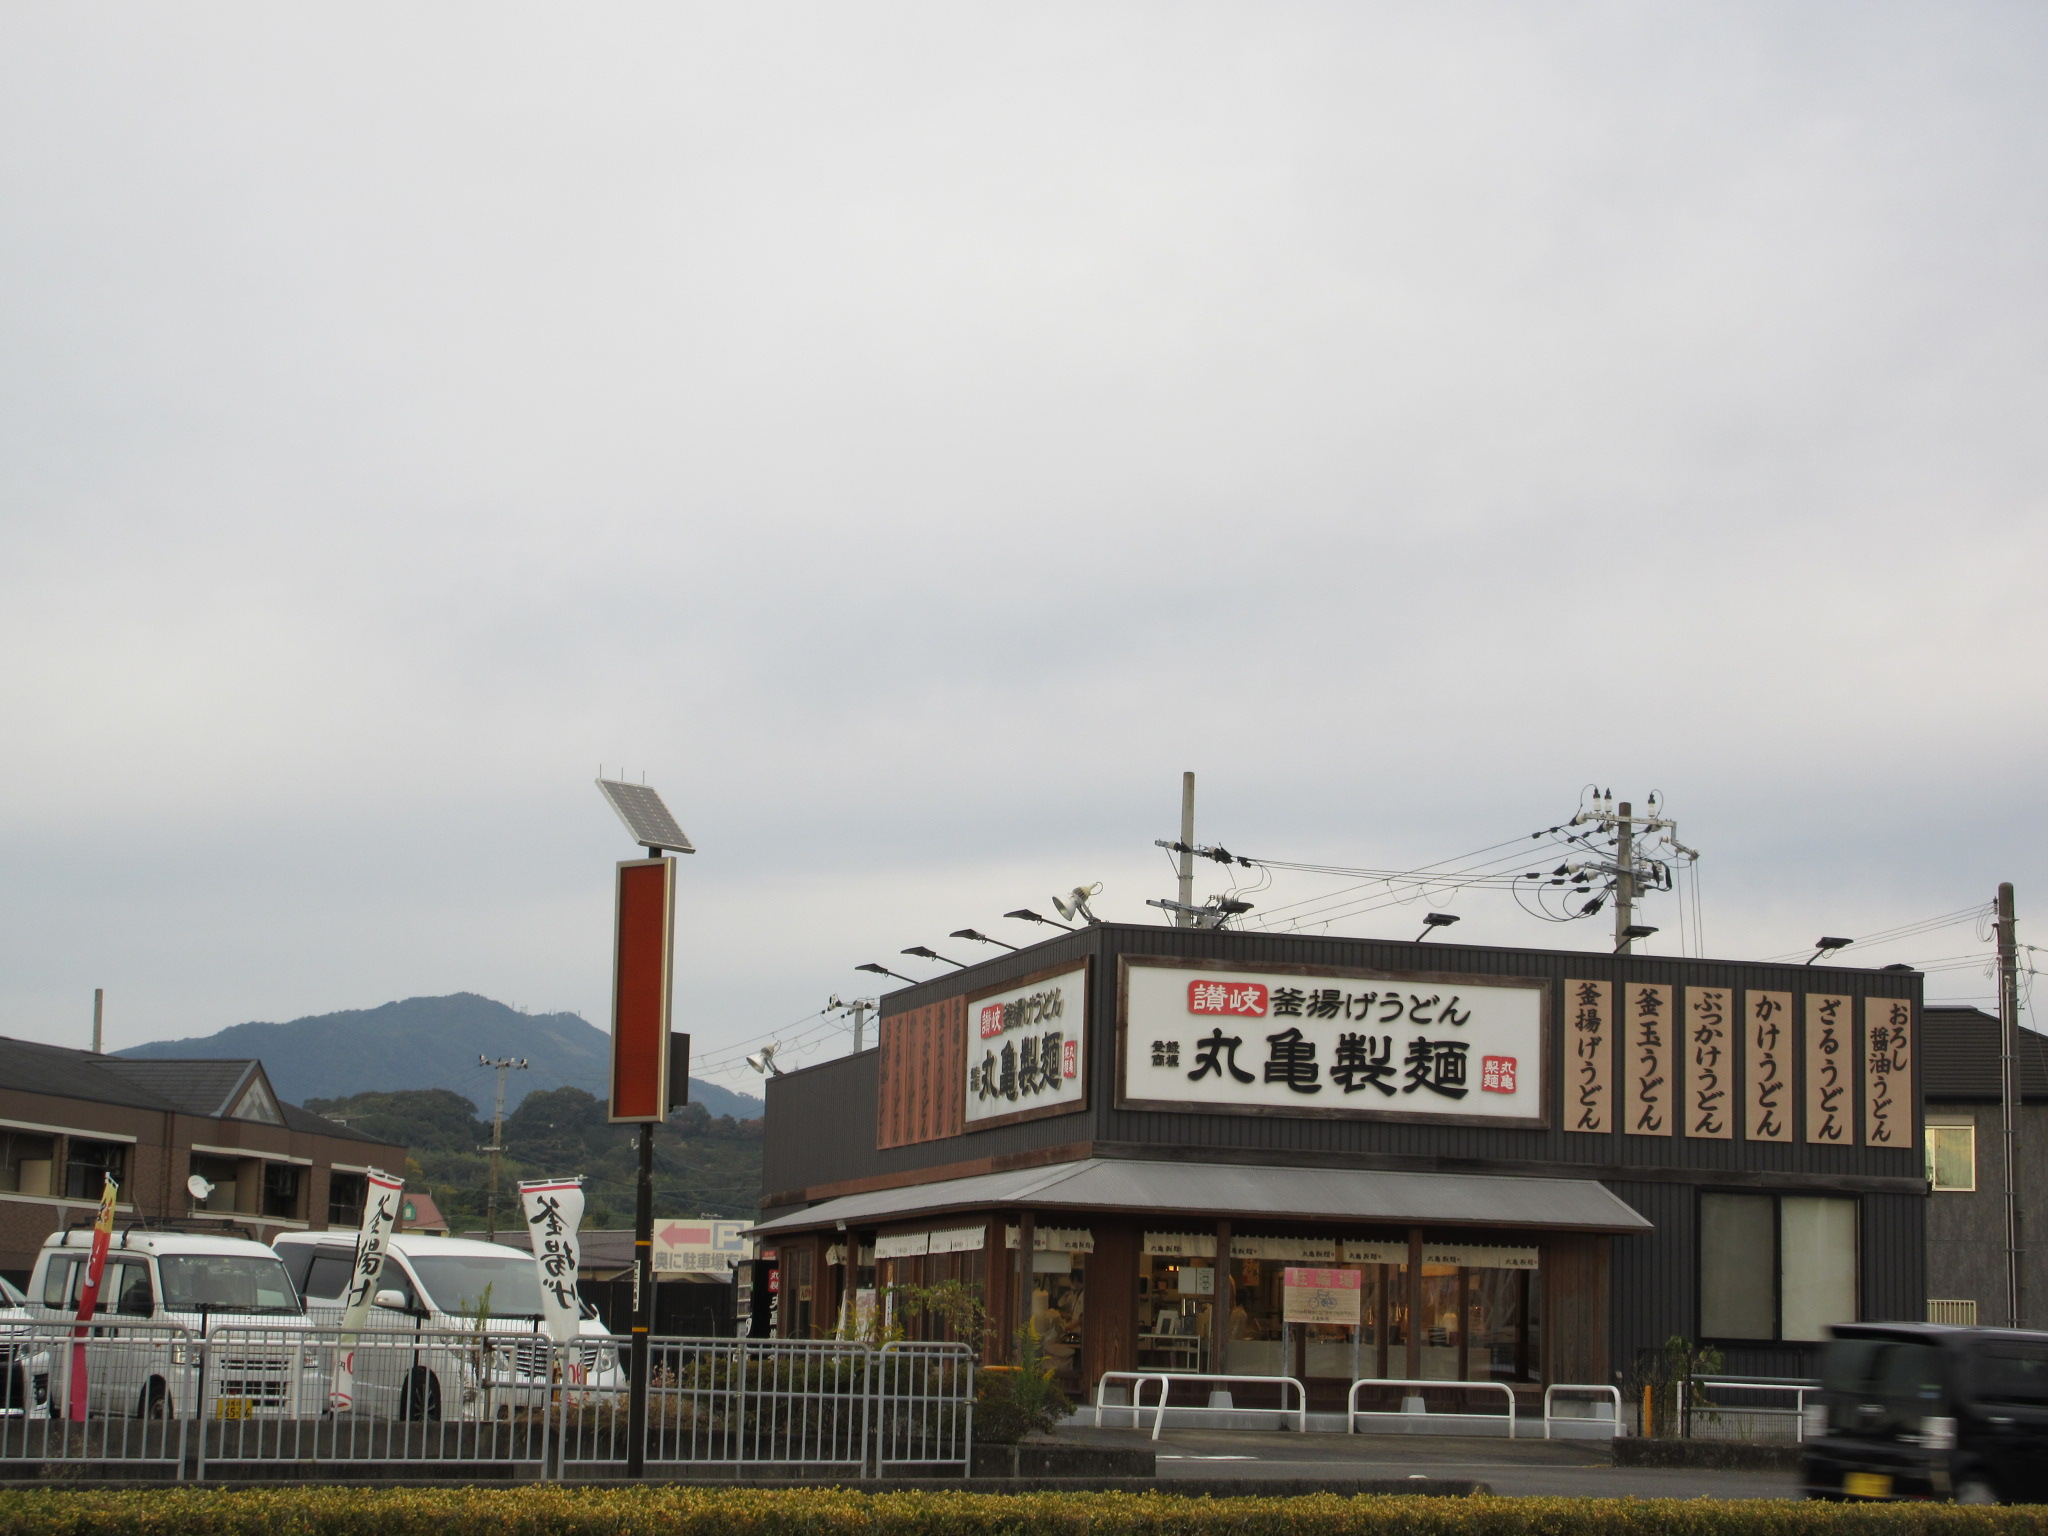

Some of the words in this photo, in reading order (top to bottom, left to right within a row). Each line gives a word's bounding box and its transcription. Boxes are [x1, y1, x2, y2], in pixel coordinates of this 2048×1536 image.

[979, 1031, 1064, 1101] 丸亀製麺
[1187, 1027, 1471, 1100] 丸亀製麺
[1193, 984, 1264, 1014] 讃岐
[1270, 987, 1471, 1026] 釜揚げうどん
[1575, 981, 1603, 1130] 釜揚げうどん
[1635, 988, 1664, 1131] 釜玉うどん
[1693, 991, 1723, 1134] ぶっかけうどん
[1755, 994, 1782, 1137] かけうどん
[1817, 998, 1843, 1140] ざるうどん
[1888, 1003, 1908, 1072] おろし
[1868, 1026, 1892, 1143] 醤油うどん
